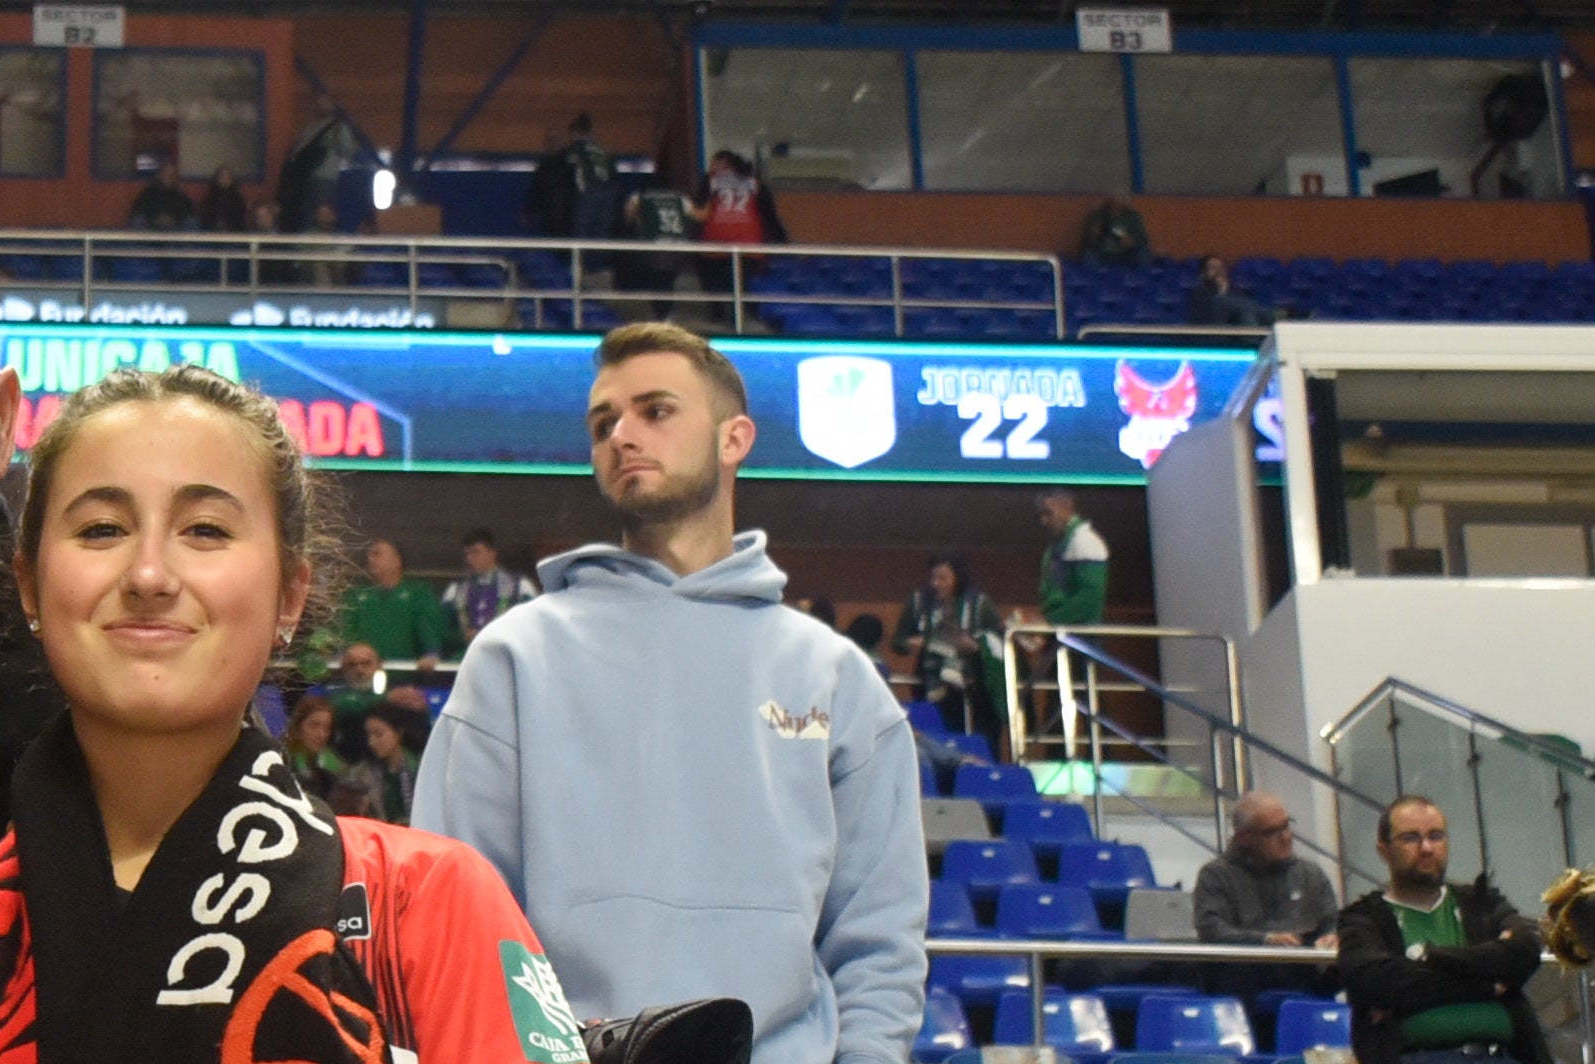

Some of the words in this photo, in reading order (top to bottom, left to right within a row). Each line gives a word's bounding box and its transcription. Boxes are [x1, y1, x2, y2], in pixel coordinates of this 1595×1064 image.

[1109, 31, 1142, 50] B3
[917, 365, 1087, 408] JORNADA
[957, 391, 1051, 460] 22
